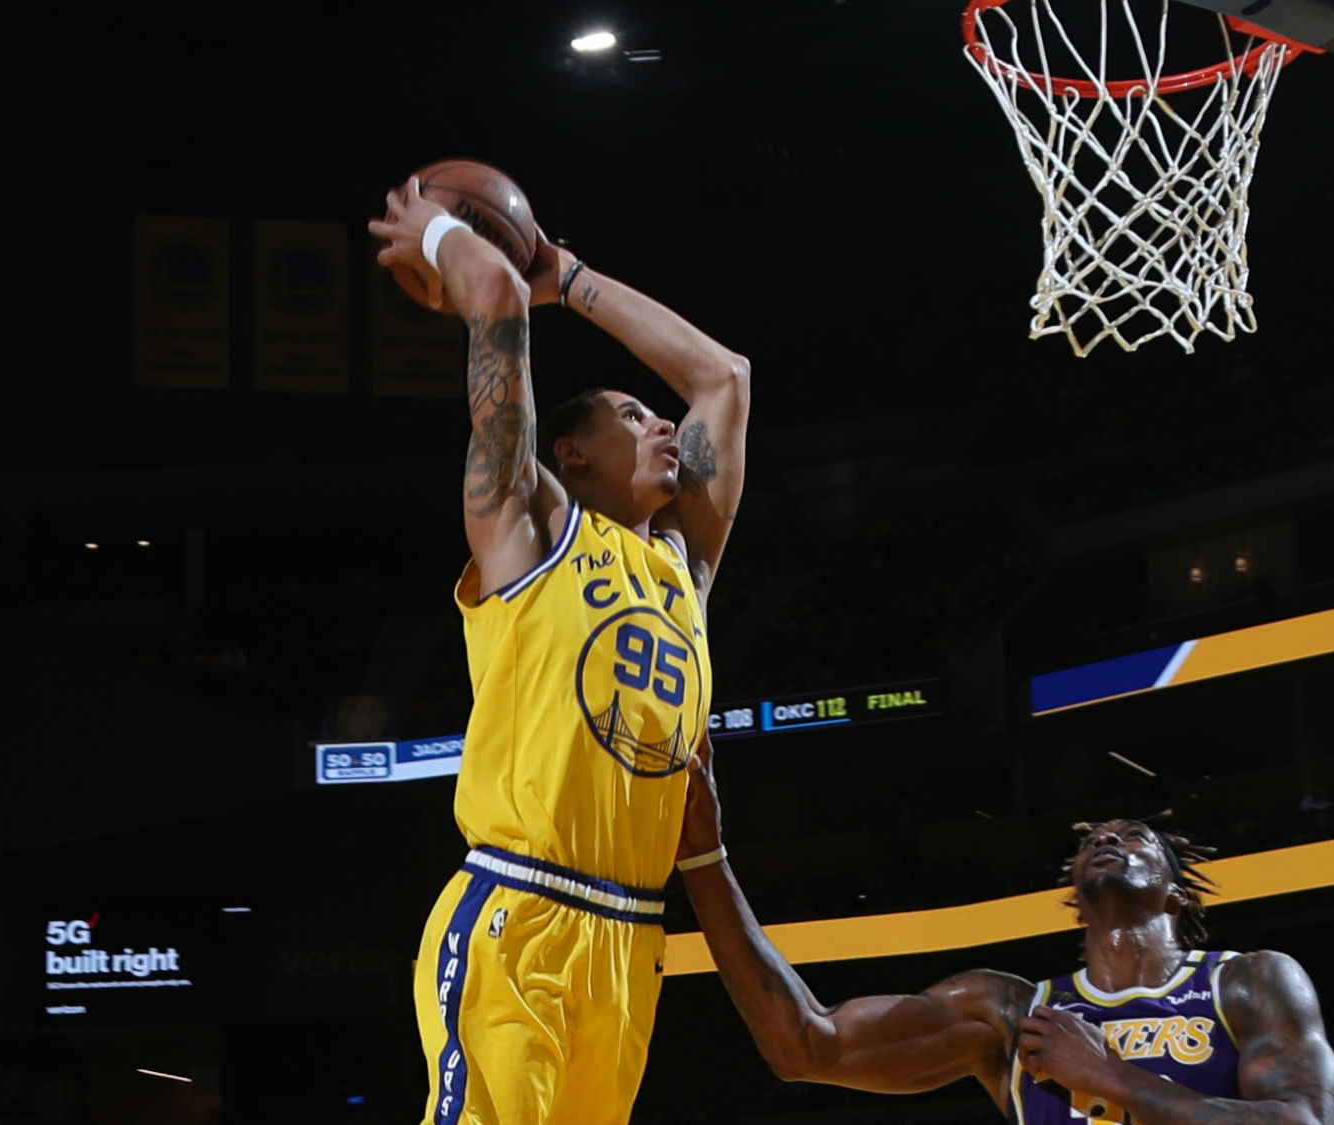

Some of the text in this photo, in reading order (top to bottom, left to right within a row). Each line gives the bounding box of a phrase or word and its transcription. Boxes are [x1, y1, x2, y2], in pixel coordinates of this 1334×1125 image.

[571, 550, 615, 574] The
[613, 622, 688, 708] 95
[773, 702, 815, 720] OKC
[867, 690, 927, 710] FINAL
[45, 919, 91, 946] 5G
[45, 946, 179, 977] built right
[1100, 1014, 1215, 1066] KERS
